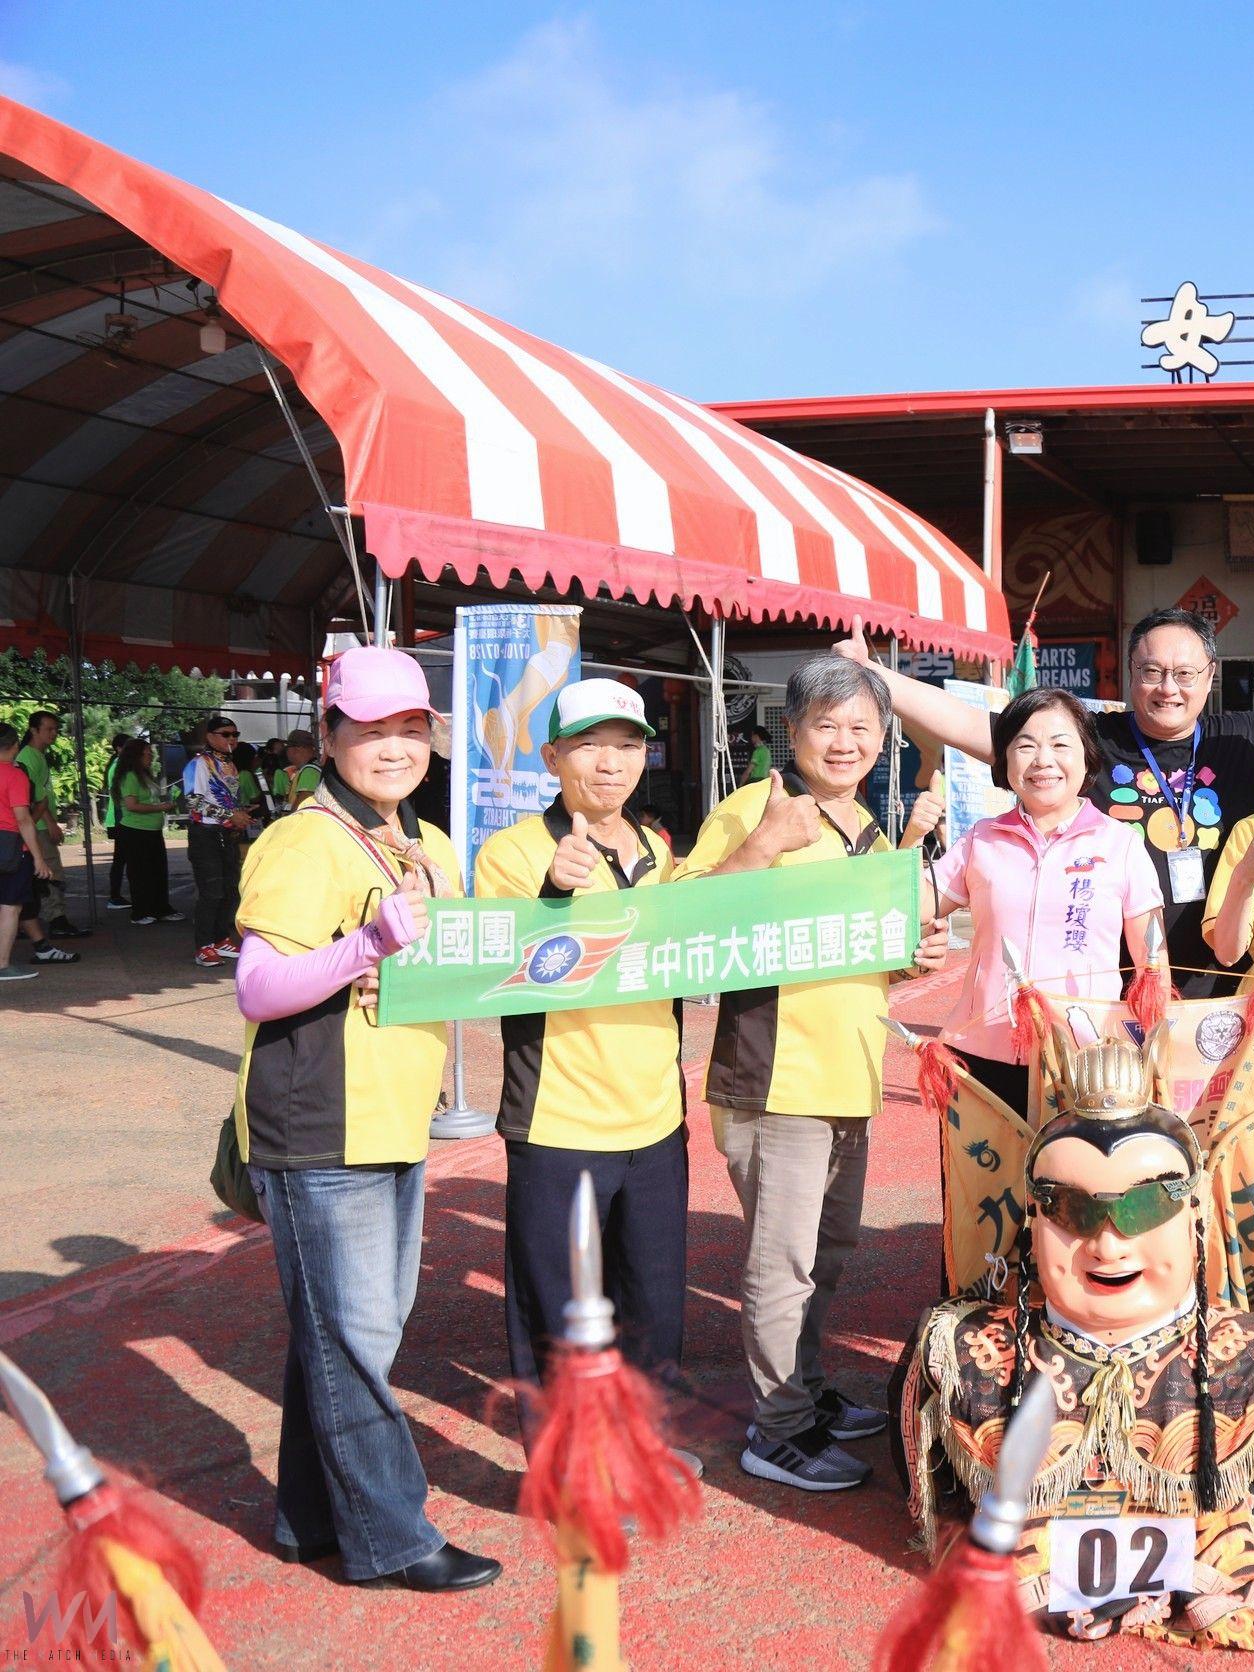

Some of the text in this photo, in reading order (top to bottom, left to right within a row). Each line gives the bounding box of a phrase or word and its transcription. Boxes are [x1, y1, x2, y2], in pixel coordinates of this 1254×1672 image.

[1035, 648, 1076, 667] EARTS
[616, 908, 908, 993] 臺中市大雅區團委會
[1063, 877, 1095, 954] 楊瓊瓔
[1078, 1526, 1168, 1598] 02
